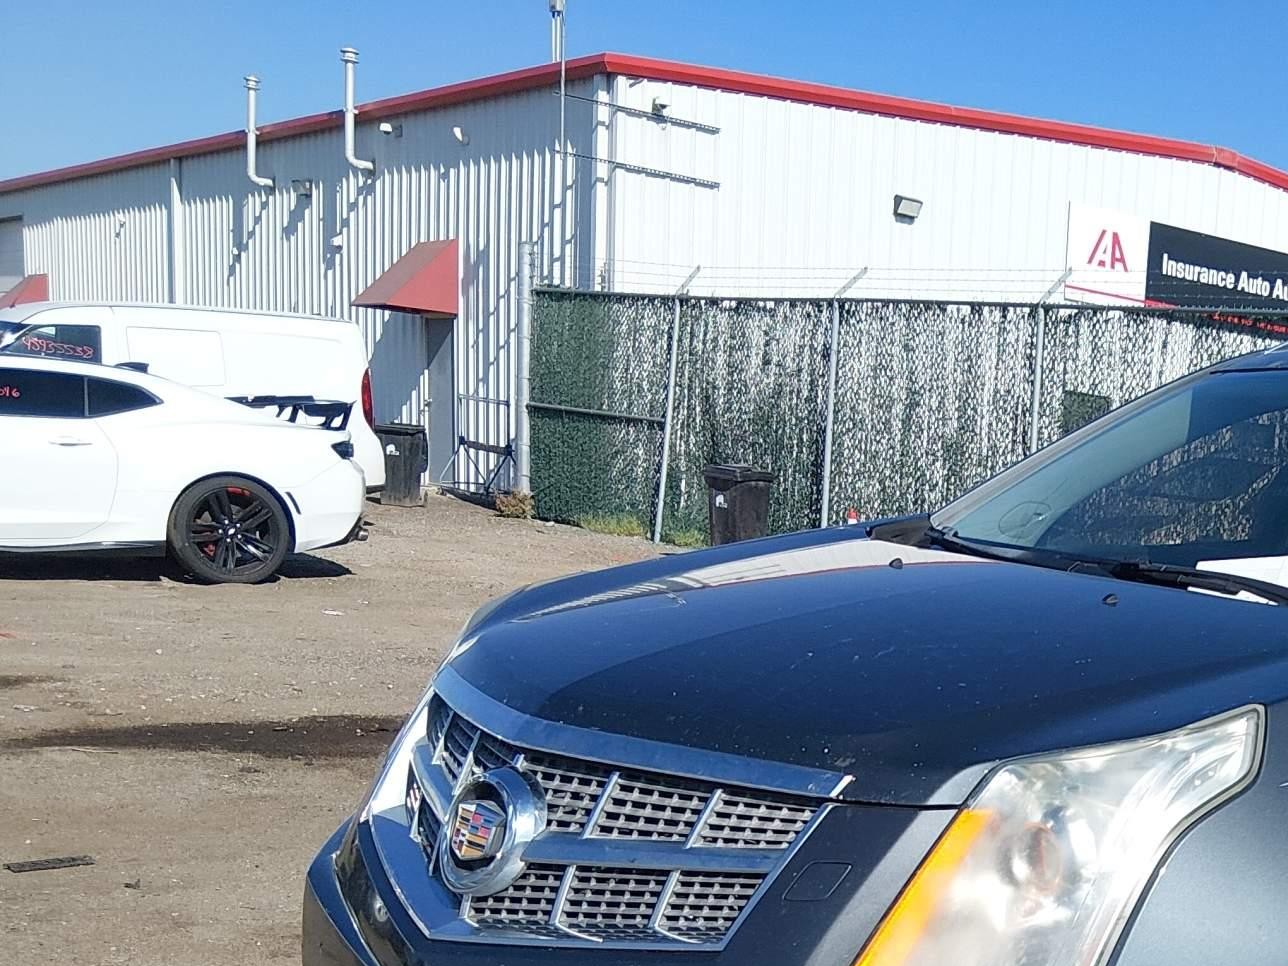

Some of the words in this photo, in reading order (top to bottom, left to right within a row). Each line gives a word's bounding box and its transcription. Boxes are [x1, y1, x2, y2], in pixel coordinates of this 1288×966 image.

[1162, 253, 1235, 290] Insurance
[1238, 271, 1270, 297] Auto
[22, 335, 94, 359] 45935538
